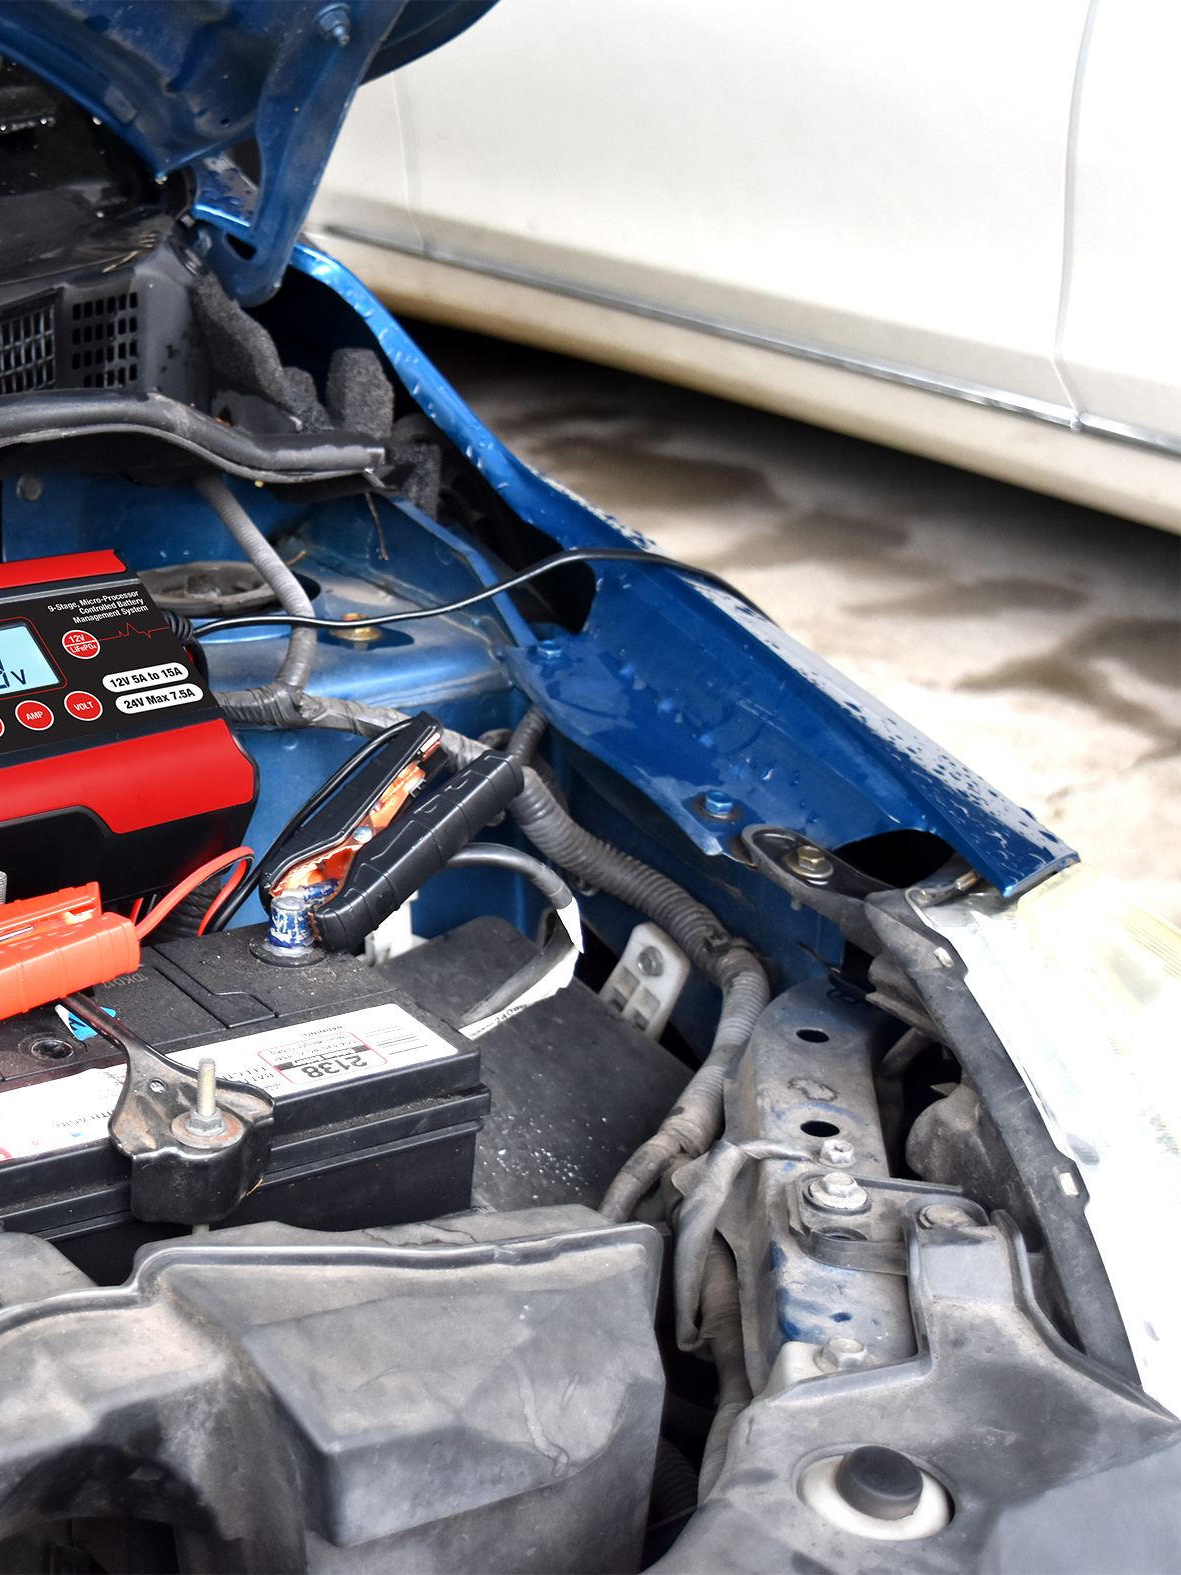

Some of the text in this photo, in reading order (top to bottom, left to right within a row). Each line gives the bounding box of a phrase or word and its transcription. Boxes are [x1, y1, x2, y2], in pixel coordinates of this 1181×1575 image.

[47, 590, 139, 612] 9-Stage, Micro-Processor
[79, 598, 144, 615] Controlled Battery
[72, 605, 149, 624] Management System
[68, 634, 85, 643] 12V
[109, 666, 183, 687] 12V 5A to 15A
[73, 701, 94, 712] VOLT
[123, 688, 196, 710] 24V Max 7.5A
[25, 710, 44, 721] AMP
[300, 1055, 368, 1079] 2138
